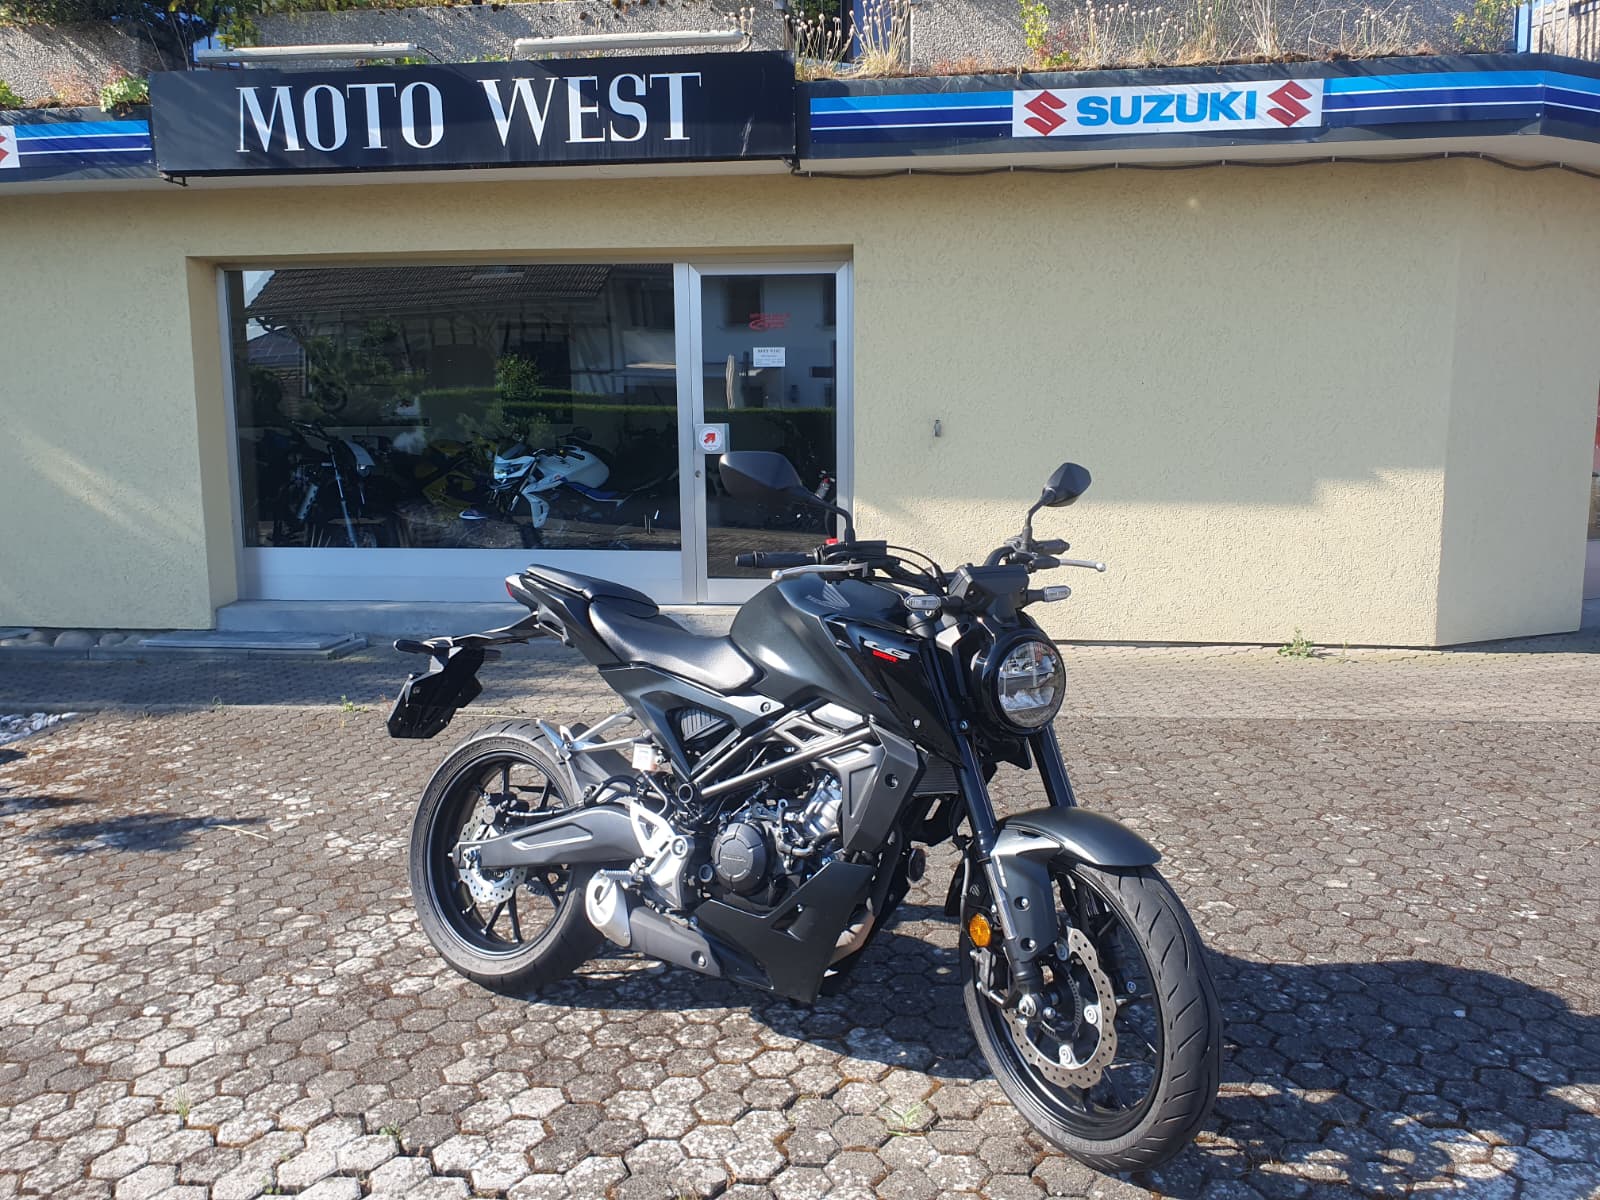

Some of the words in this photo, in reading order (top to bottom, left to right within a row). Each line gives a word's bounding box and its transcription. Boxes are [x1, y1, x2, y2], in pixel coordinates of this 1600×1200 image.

[236, 81, 444, 153] MOTO
[476, 71, 702, 147] WEST
[1076, 90, 1257, 127] SUZUKI
